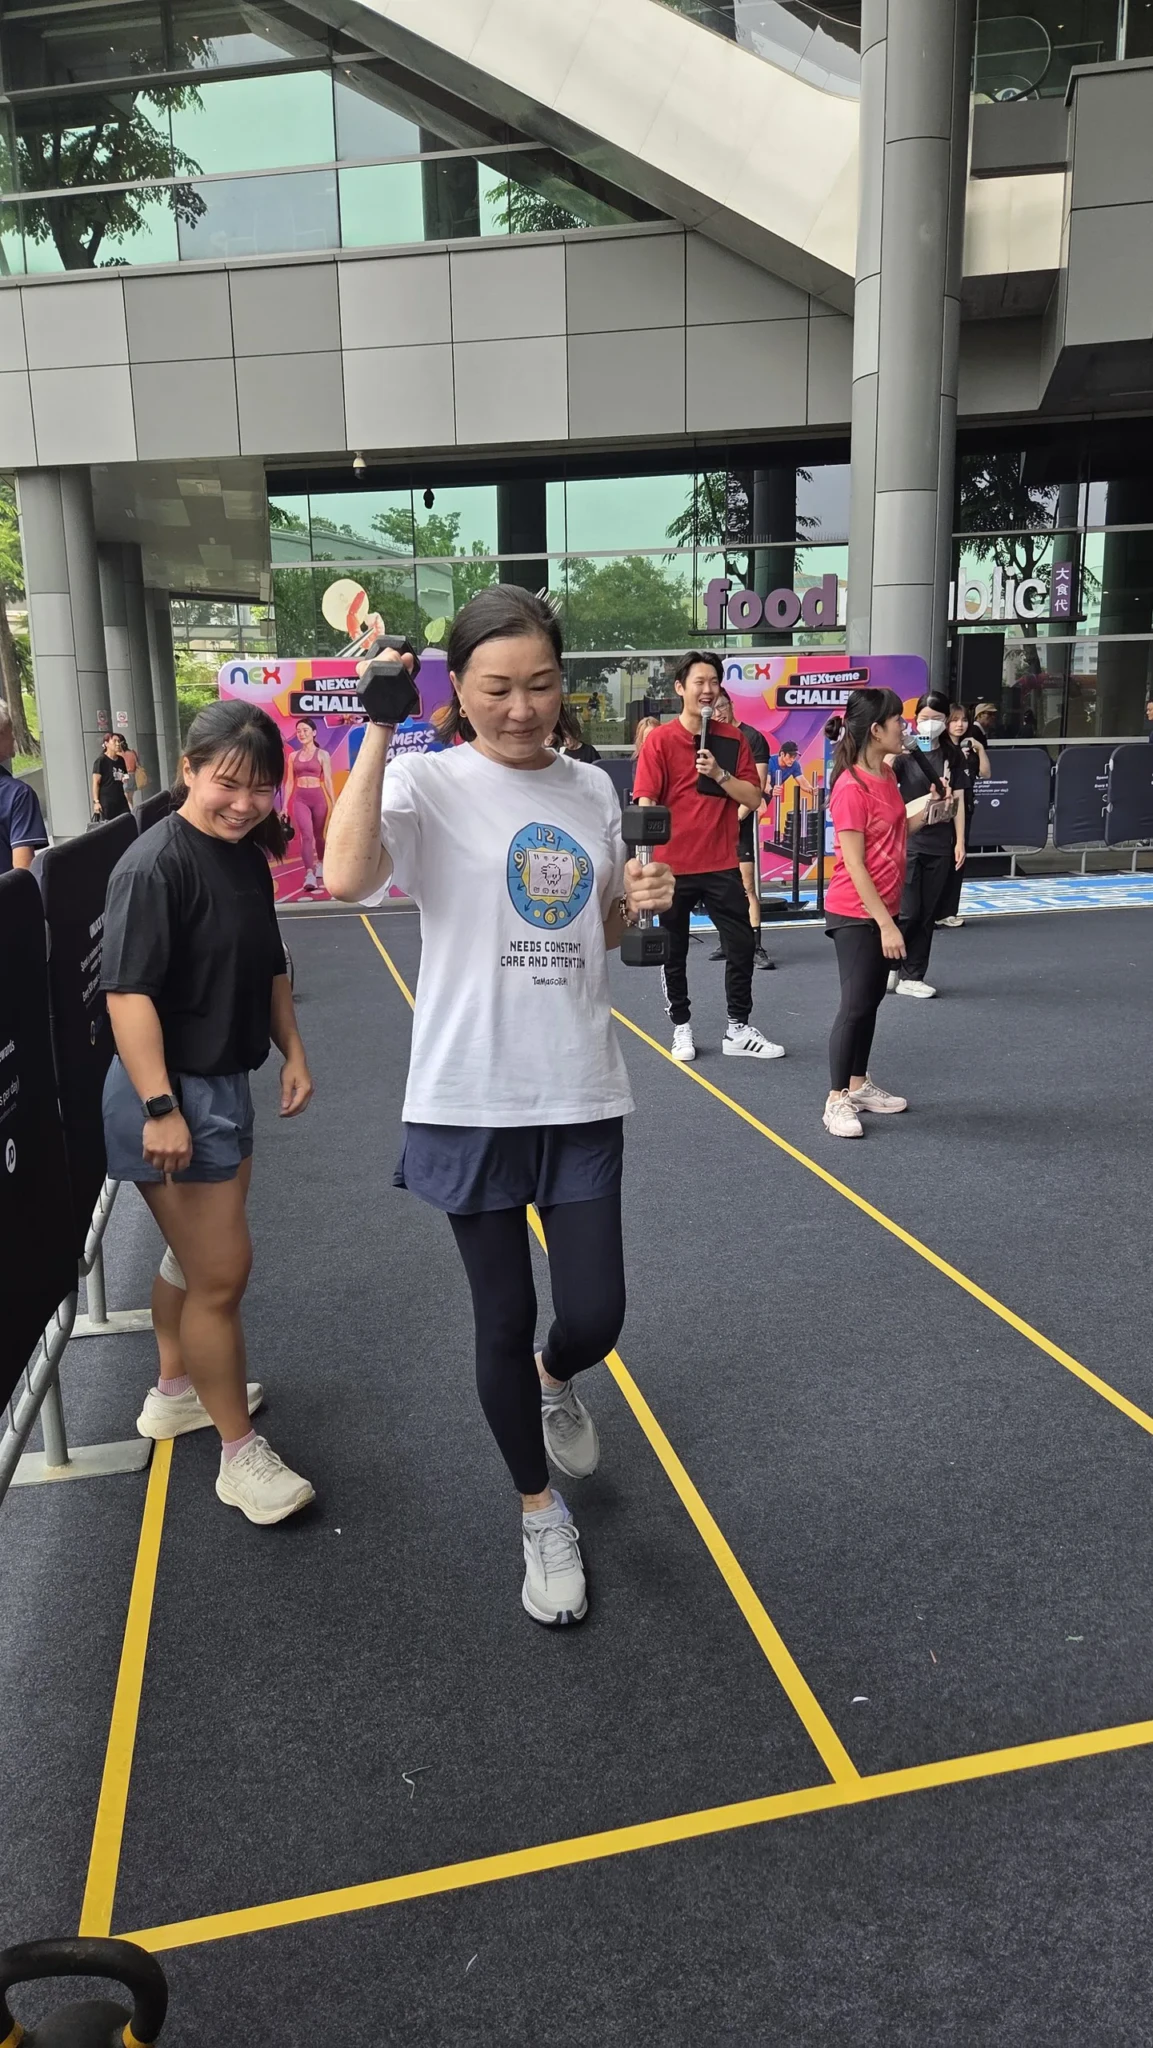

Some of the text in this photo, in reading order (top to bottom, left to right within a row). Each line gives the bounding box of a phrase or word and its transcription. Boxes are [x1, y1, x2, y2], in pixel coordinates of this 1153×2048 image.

[1054, 567, 1070, 612] 大食代
[703, 573, 838, 629] food
[800, 671, 860, 686] NEXtreme
[299, 694, 367, 712] CHALL
[784, 689, 855, 705] CHALLE
[389, 729, 435, 747] MER'S
[537, 826, 556, 844] 12
[513, 850, 589, 875] 9 3
[543, 906, 558, 925] 6
[510, 940, 581, 954] NEEDS CONSTANT
[500, 955, 585, 969] CARE AND ATTENTION
